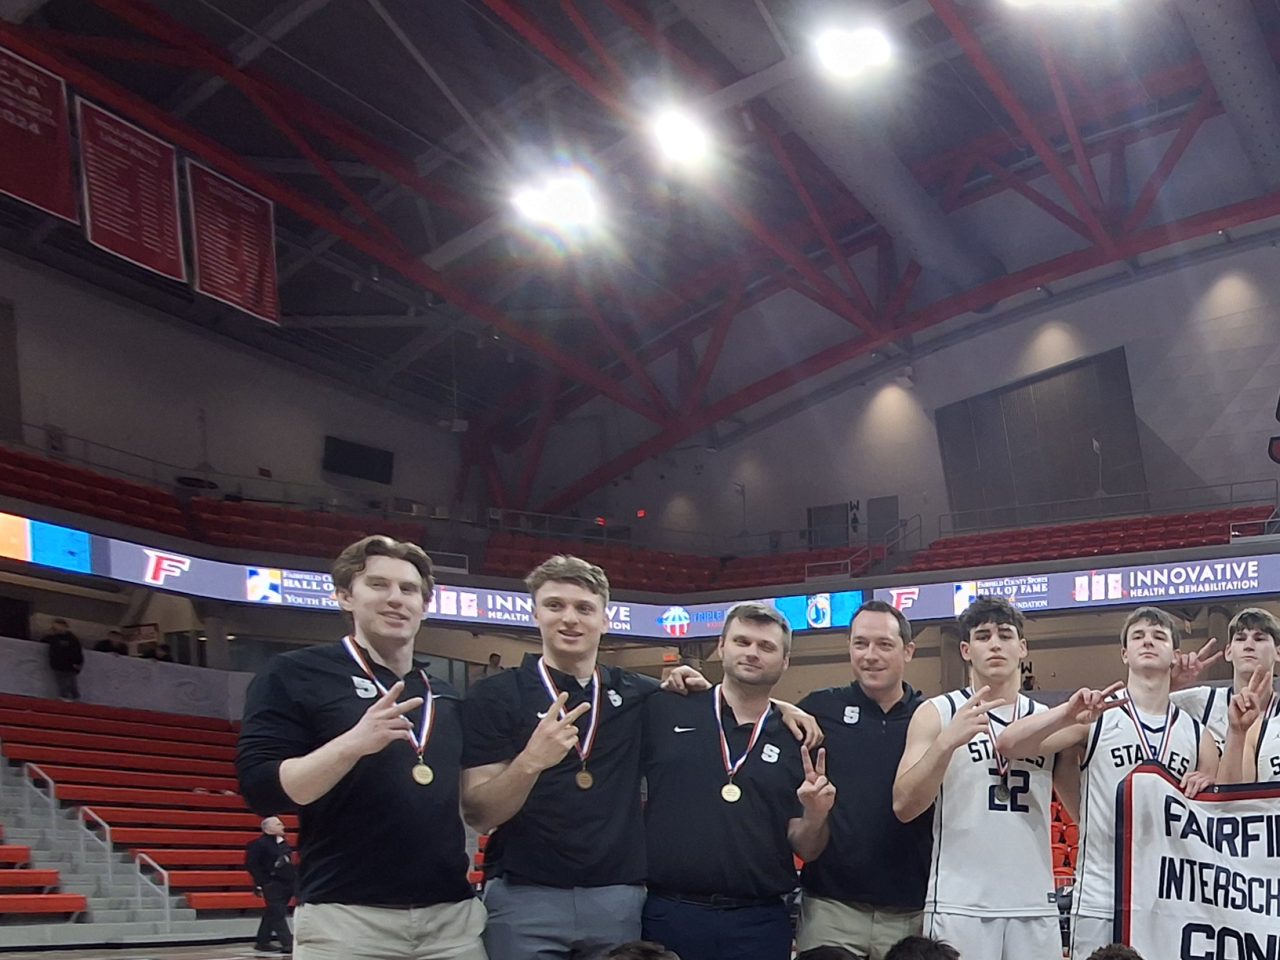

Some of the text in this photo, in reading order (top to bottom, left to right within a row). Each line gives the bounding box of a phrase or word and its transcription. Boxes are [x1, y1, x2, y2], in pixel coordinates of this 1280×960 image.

[142, 548, 191, 586] F
[1129, 560, 1260, 588] INNOVATIVE
[283, 578, 321, 591] HALL
[977, 585, 1003, 596] HALL
[1020, 583, 1048, 594] FAME
[1130, 587, 1165, 598] HEALTH
[1178, 579, 1259, 594] REHABILITATION
[487, 610, 529, 622] HEALTH
[1021, 661, 1032, 674] W
[843, 705, 860, 724] S
[761, 743, 780, 763] S
[1111, 744, 1190, 777] STAES
[988, 768, 1031, 813] 22
